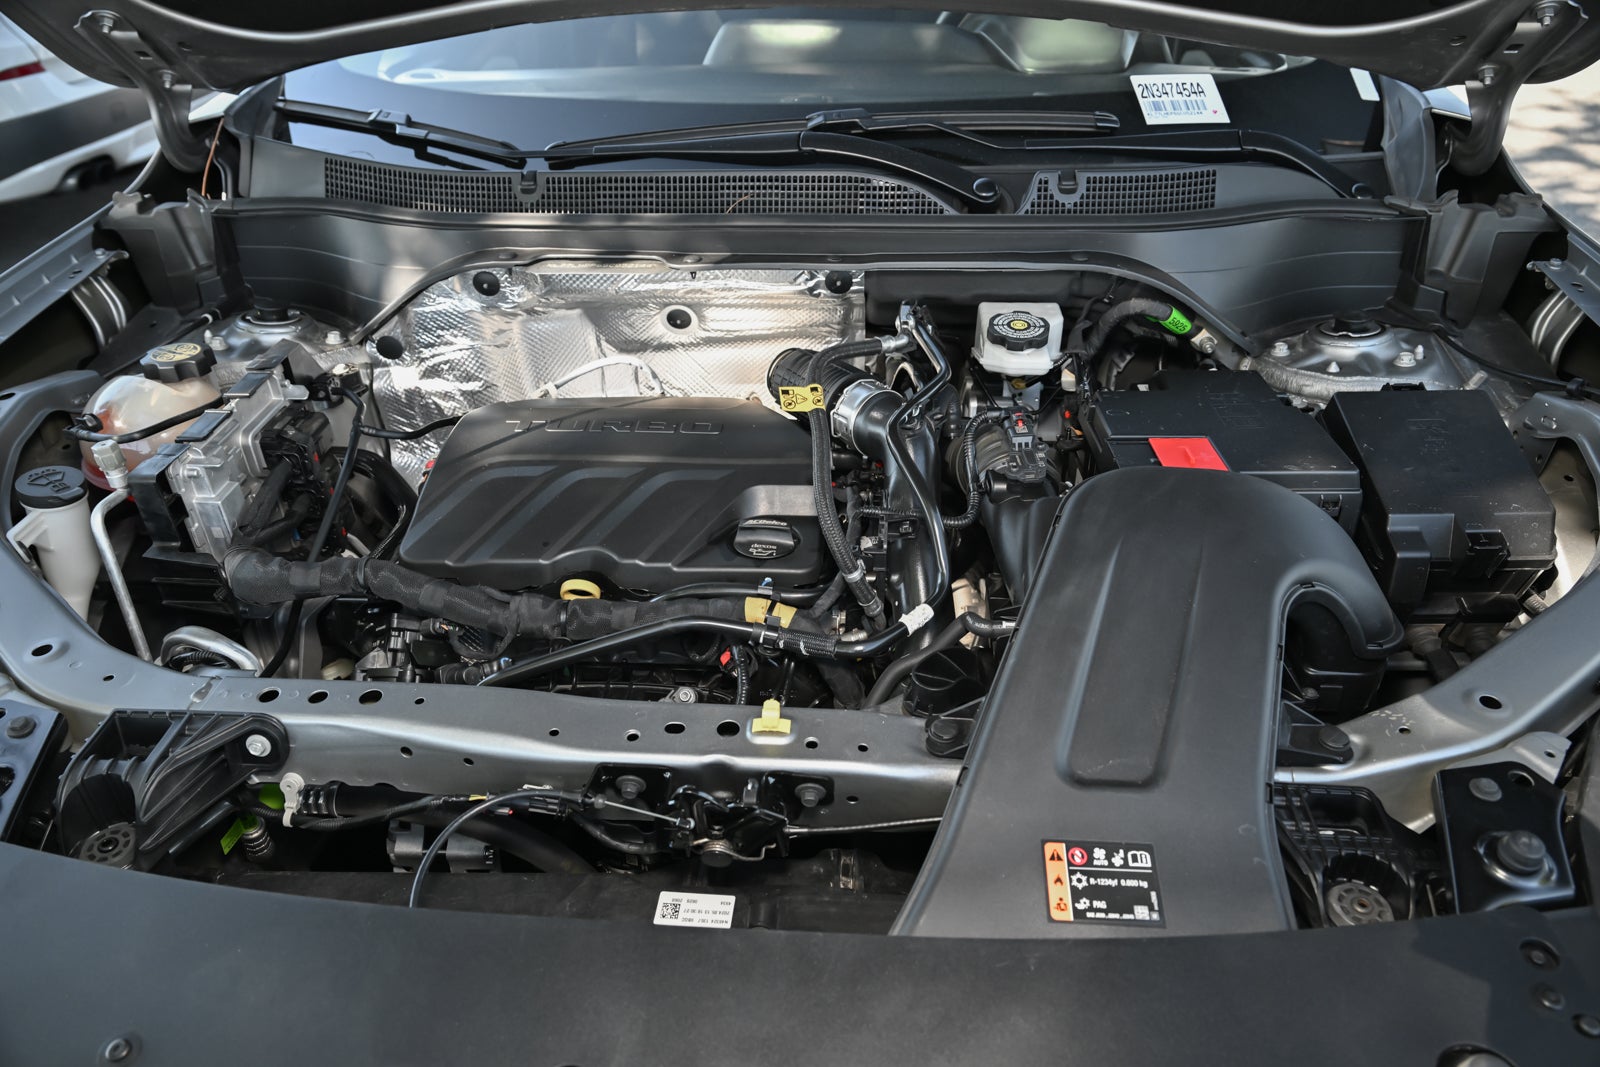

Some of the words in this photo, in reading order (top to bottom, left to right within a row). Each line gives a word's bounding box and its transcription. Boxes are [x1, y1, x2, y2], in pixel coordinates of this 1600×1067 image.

[1138, 83, 1206, 99] 2N347454A
[505, 420, 724, 435] TURBO
[1092, 900, 1107, 909] PAG
